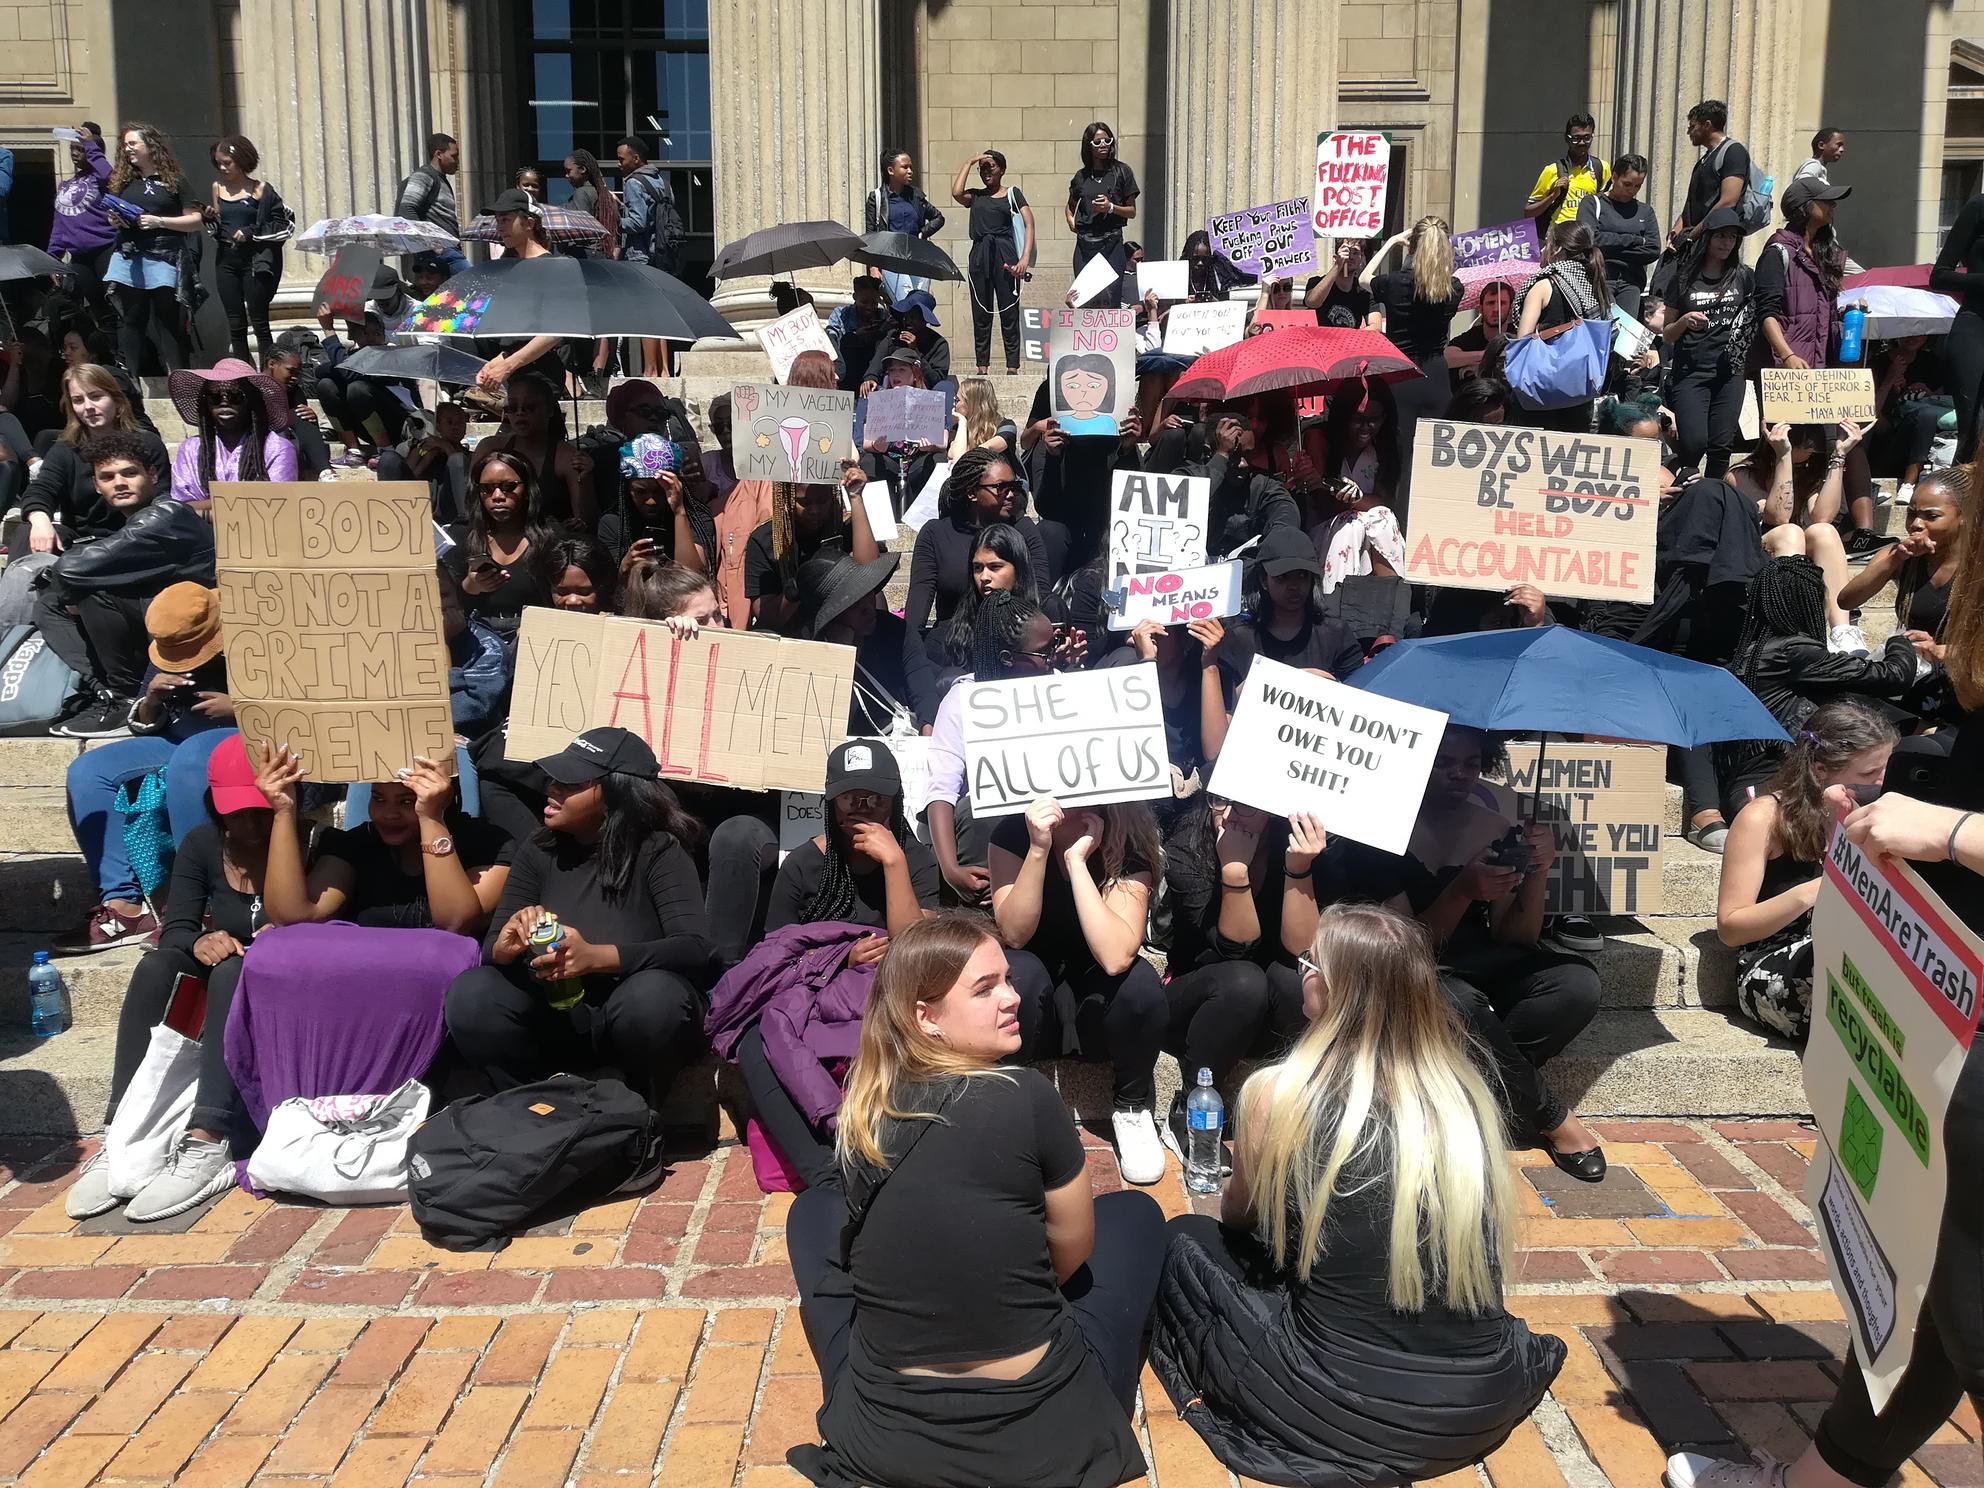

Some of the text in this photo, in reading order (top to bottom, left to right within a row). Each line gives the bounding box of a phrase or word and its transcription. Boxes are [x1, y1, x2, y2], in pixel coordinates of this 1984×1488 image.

[1331, 135, 1381, 158] THE
[1318, 161, 1387, 183] FUCKING
[1323, 185, 1382, 207] POST
[1315, 211, 1380, 229] OFFICE
[1499, 242, 1531, 262] ARE
[1058, 310, 1133, 328] I SAID
[1072, 330, 1118, 351] NO
[1763, 371, 1856, 381] LEAVING BEHIND
[1764, 382, 1800, 392] NIGHTS
[1805, 382, 1818, 392] OF
[1822, 382, 1860, 392] TERROR
[765, 389, 790, 408] MY
[799, 393, 852, 412] VAGINA
[1798, 391, 1803, 402] I
[1837, 404, 1876, 418] ANGELOU
[749, 453, 777, 476] MY
[1431, 424, 1640, 482] BOYS WILL
[1119, 475, 1190, 519] AM
[1477, 470, 1641, 521] BE BOYS
[213, 496, 431, 559] MY BODY
[1492, 511, 1574, 538] HELD
[1137, 519, 1174, 564] I
[1408, 534, 1639, 589] ACCOUNTABLE
[1129, 574, 1183, 596] NO
[1152, 587, 1219, 607] MEANS
[219, 570, 436, 630] IS NOT A
[1170, 601, 1213, 622] NO
[1, 638, 46, 702] Kappa
[228, 630, 442, 699] CRIME
[527, 628, 838, 782] YES ALL MEN
[969, 676, 1151, 728] SHE IS
[1262, 683, 1423, 749] WOMXN DON'T
[241, 705, 453, 782] SCENE
[1278, 724, 1381, 771] OWE YOU
[976, 749, 1052, 802] ALL
[1117, 736, 1160, 783] US
[1287, 760, 1349, 794] SHIT!
[1503, 760, 1612, 788] WOMEN
[787, 805, 822, 820] DOES
[1517, 792, 1594, 821] DON'T
[1541, 823, 1659, 851] WE YOU
[1833, 833, 1974, 1018] #MenAreTrash
[1843, 955, 1902, 1058] but trash is
[1831, 984, 1927, 1151] recyclable
[1828, 1195, 1841, 1233] words,
[1840, 1228, 1856, 1268] actions
[1853, 1268, 1863, 1290] and
[1861, 1287, 1883, 1344] thoughts!
